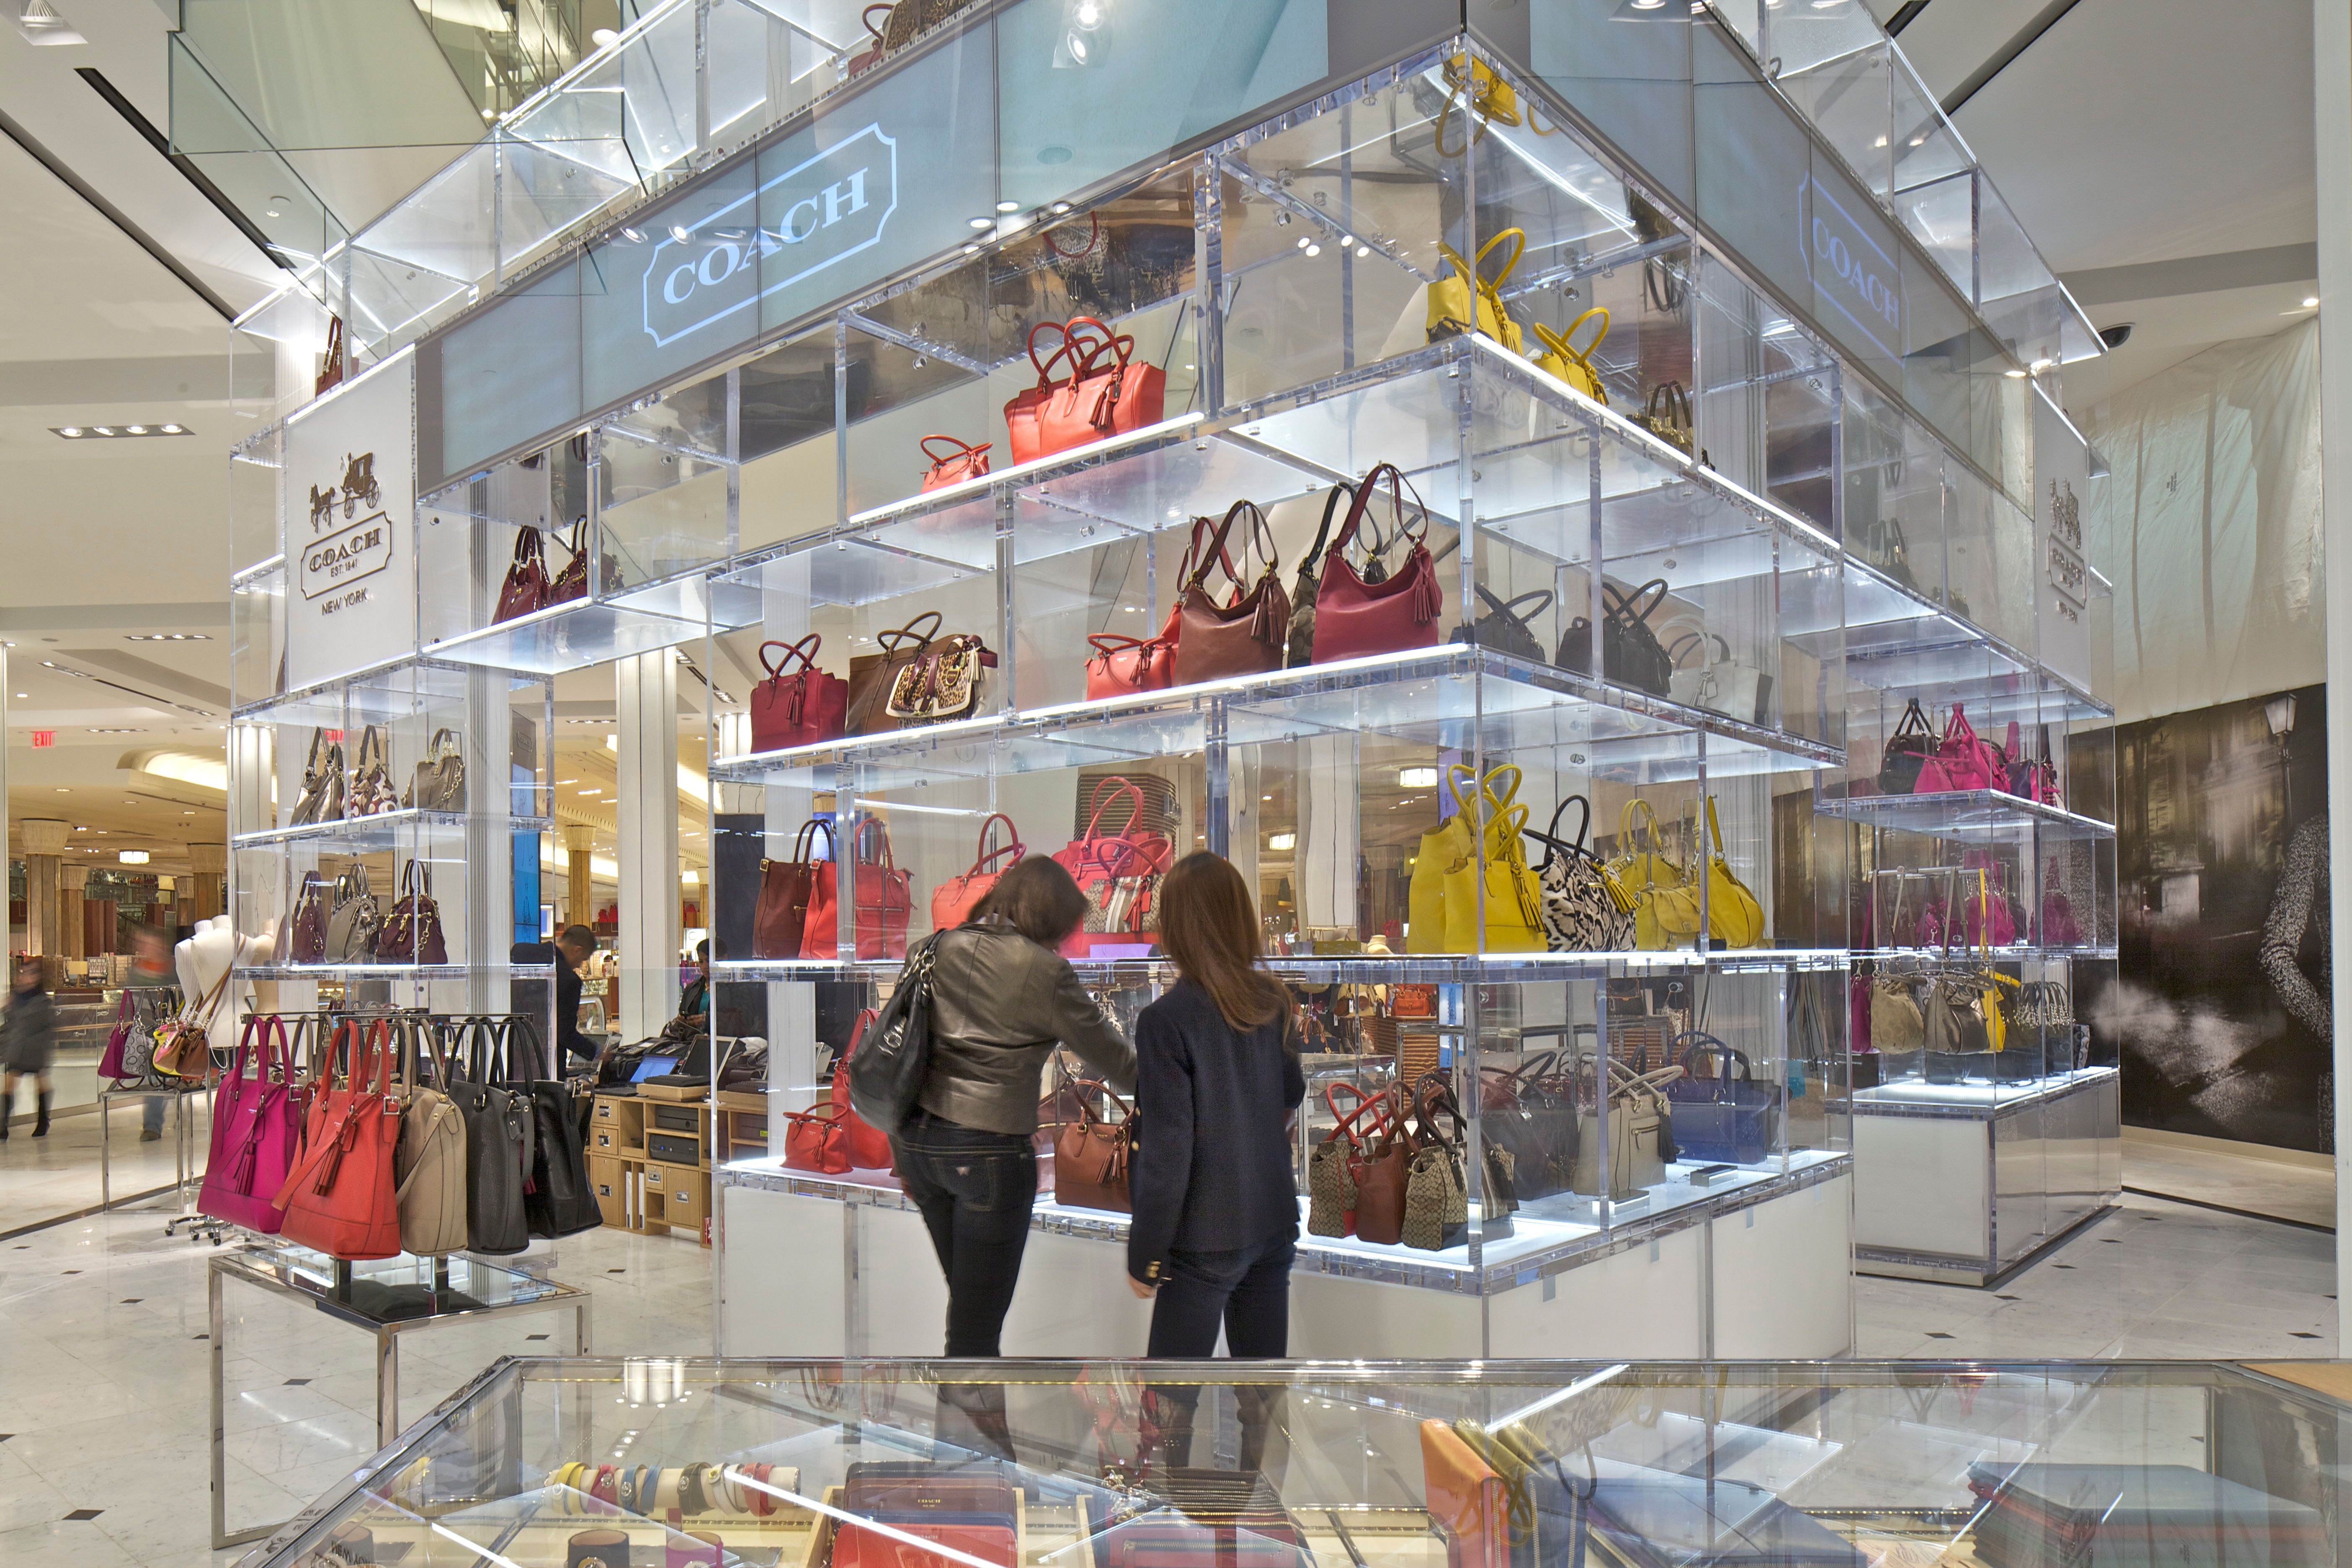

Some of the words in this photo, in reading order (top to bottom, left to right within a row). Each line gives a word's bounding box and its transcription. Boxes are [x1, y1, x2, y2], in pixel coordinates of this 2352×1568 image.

[664, 167, 869, 304] COACH
[1812, 217, 1899, 330] COACH
[309, 528, 381, 572] COACH
[330, 564, 343, 578] EST.
[345, 558, 358, 571] 1941
[322, 597, 341, 616] NEW
[344, 587, 367, 607] YORK
[35, 731, 52, 746] EXIT
